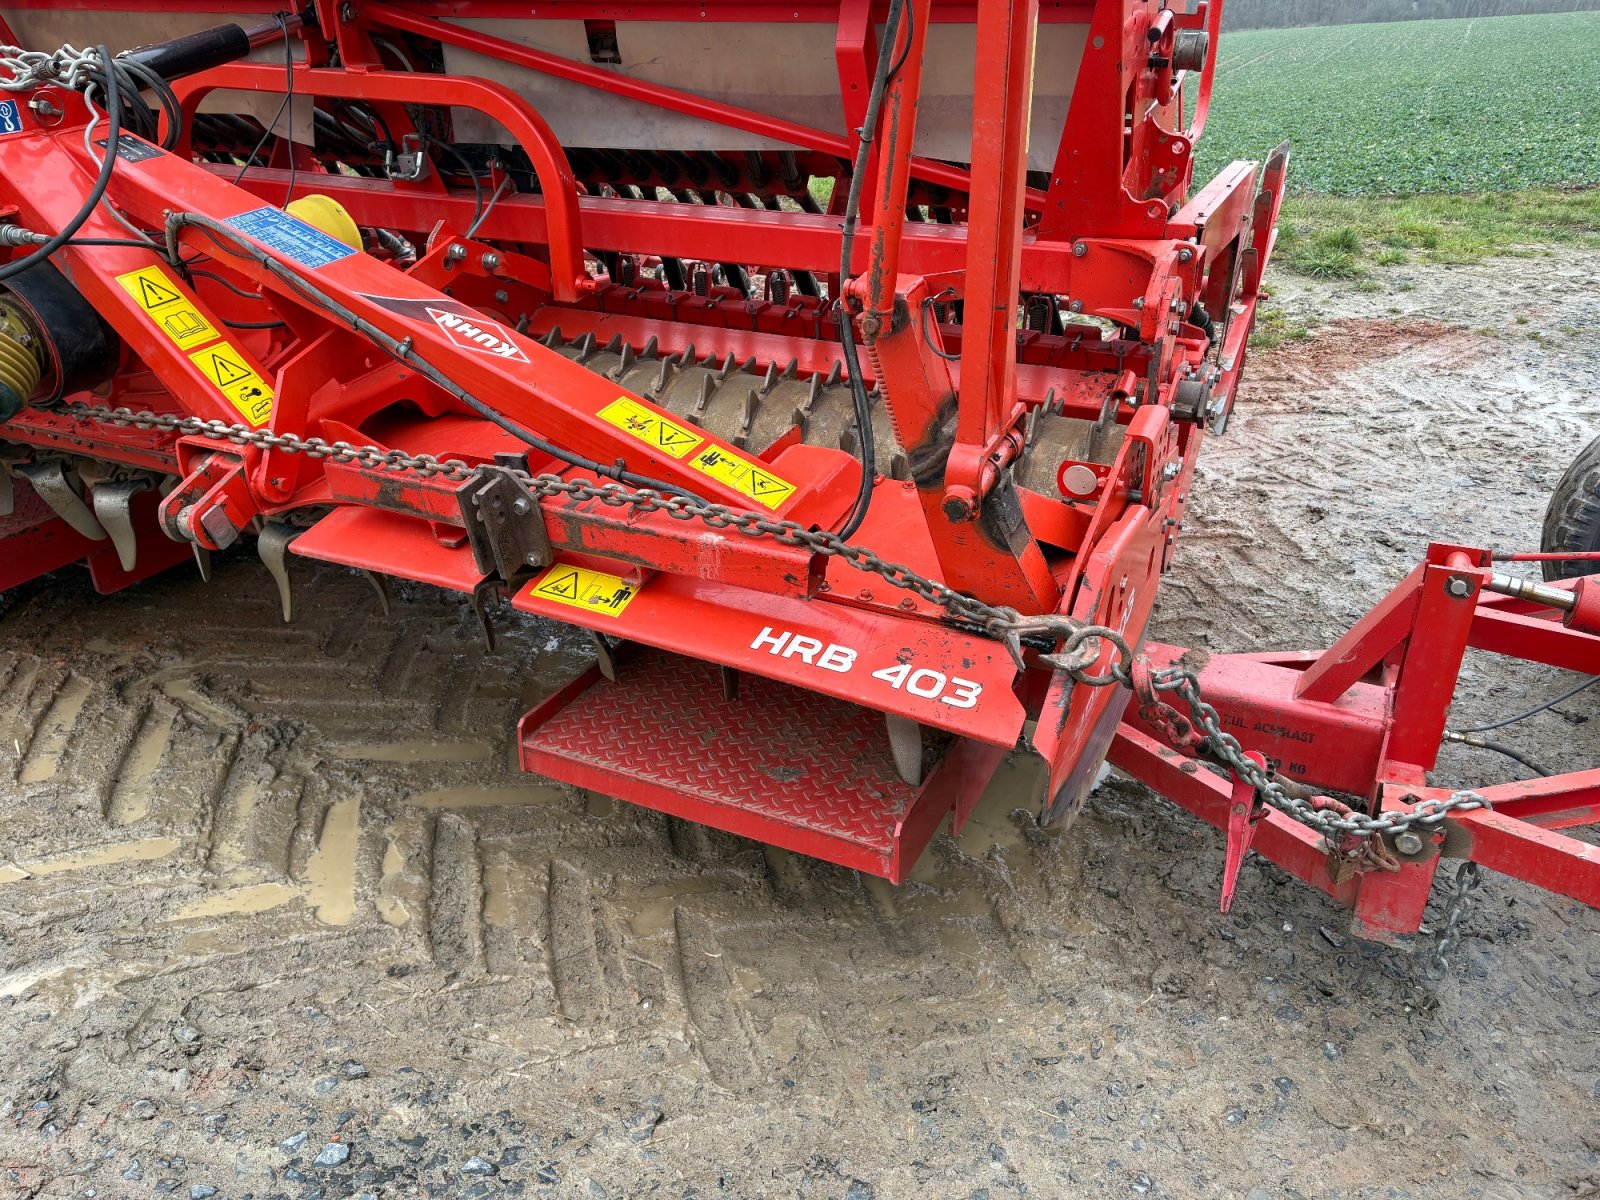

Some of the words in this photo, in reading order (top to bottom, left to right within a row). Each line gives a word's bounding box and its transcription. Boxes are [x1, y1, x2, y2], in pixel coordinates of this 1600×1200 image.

[436, 312, 519, 358] KUHN
[749, 626, 858, 673] HRB
[871, 663, 984, 709] 403
[1289, 761, 1307, 774] KG
